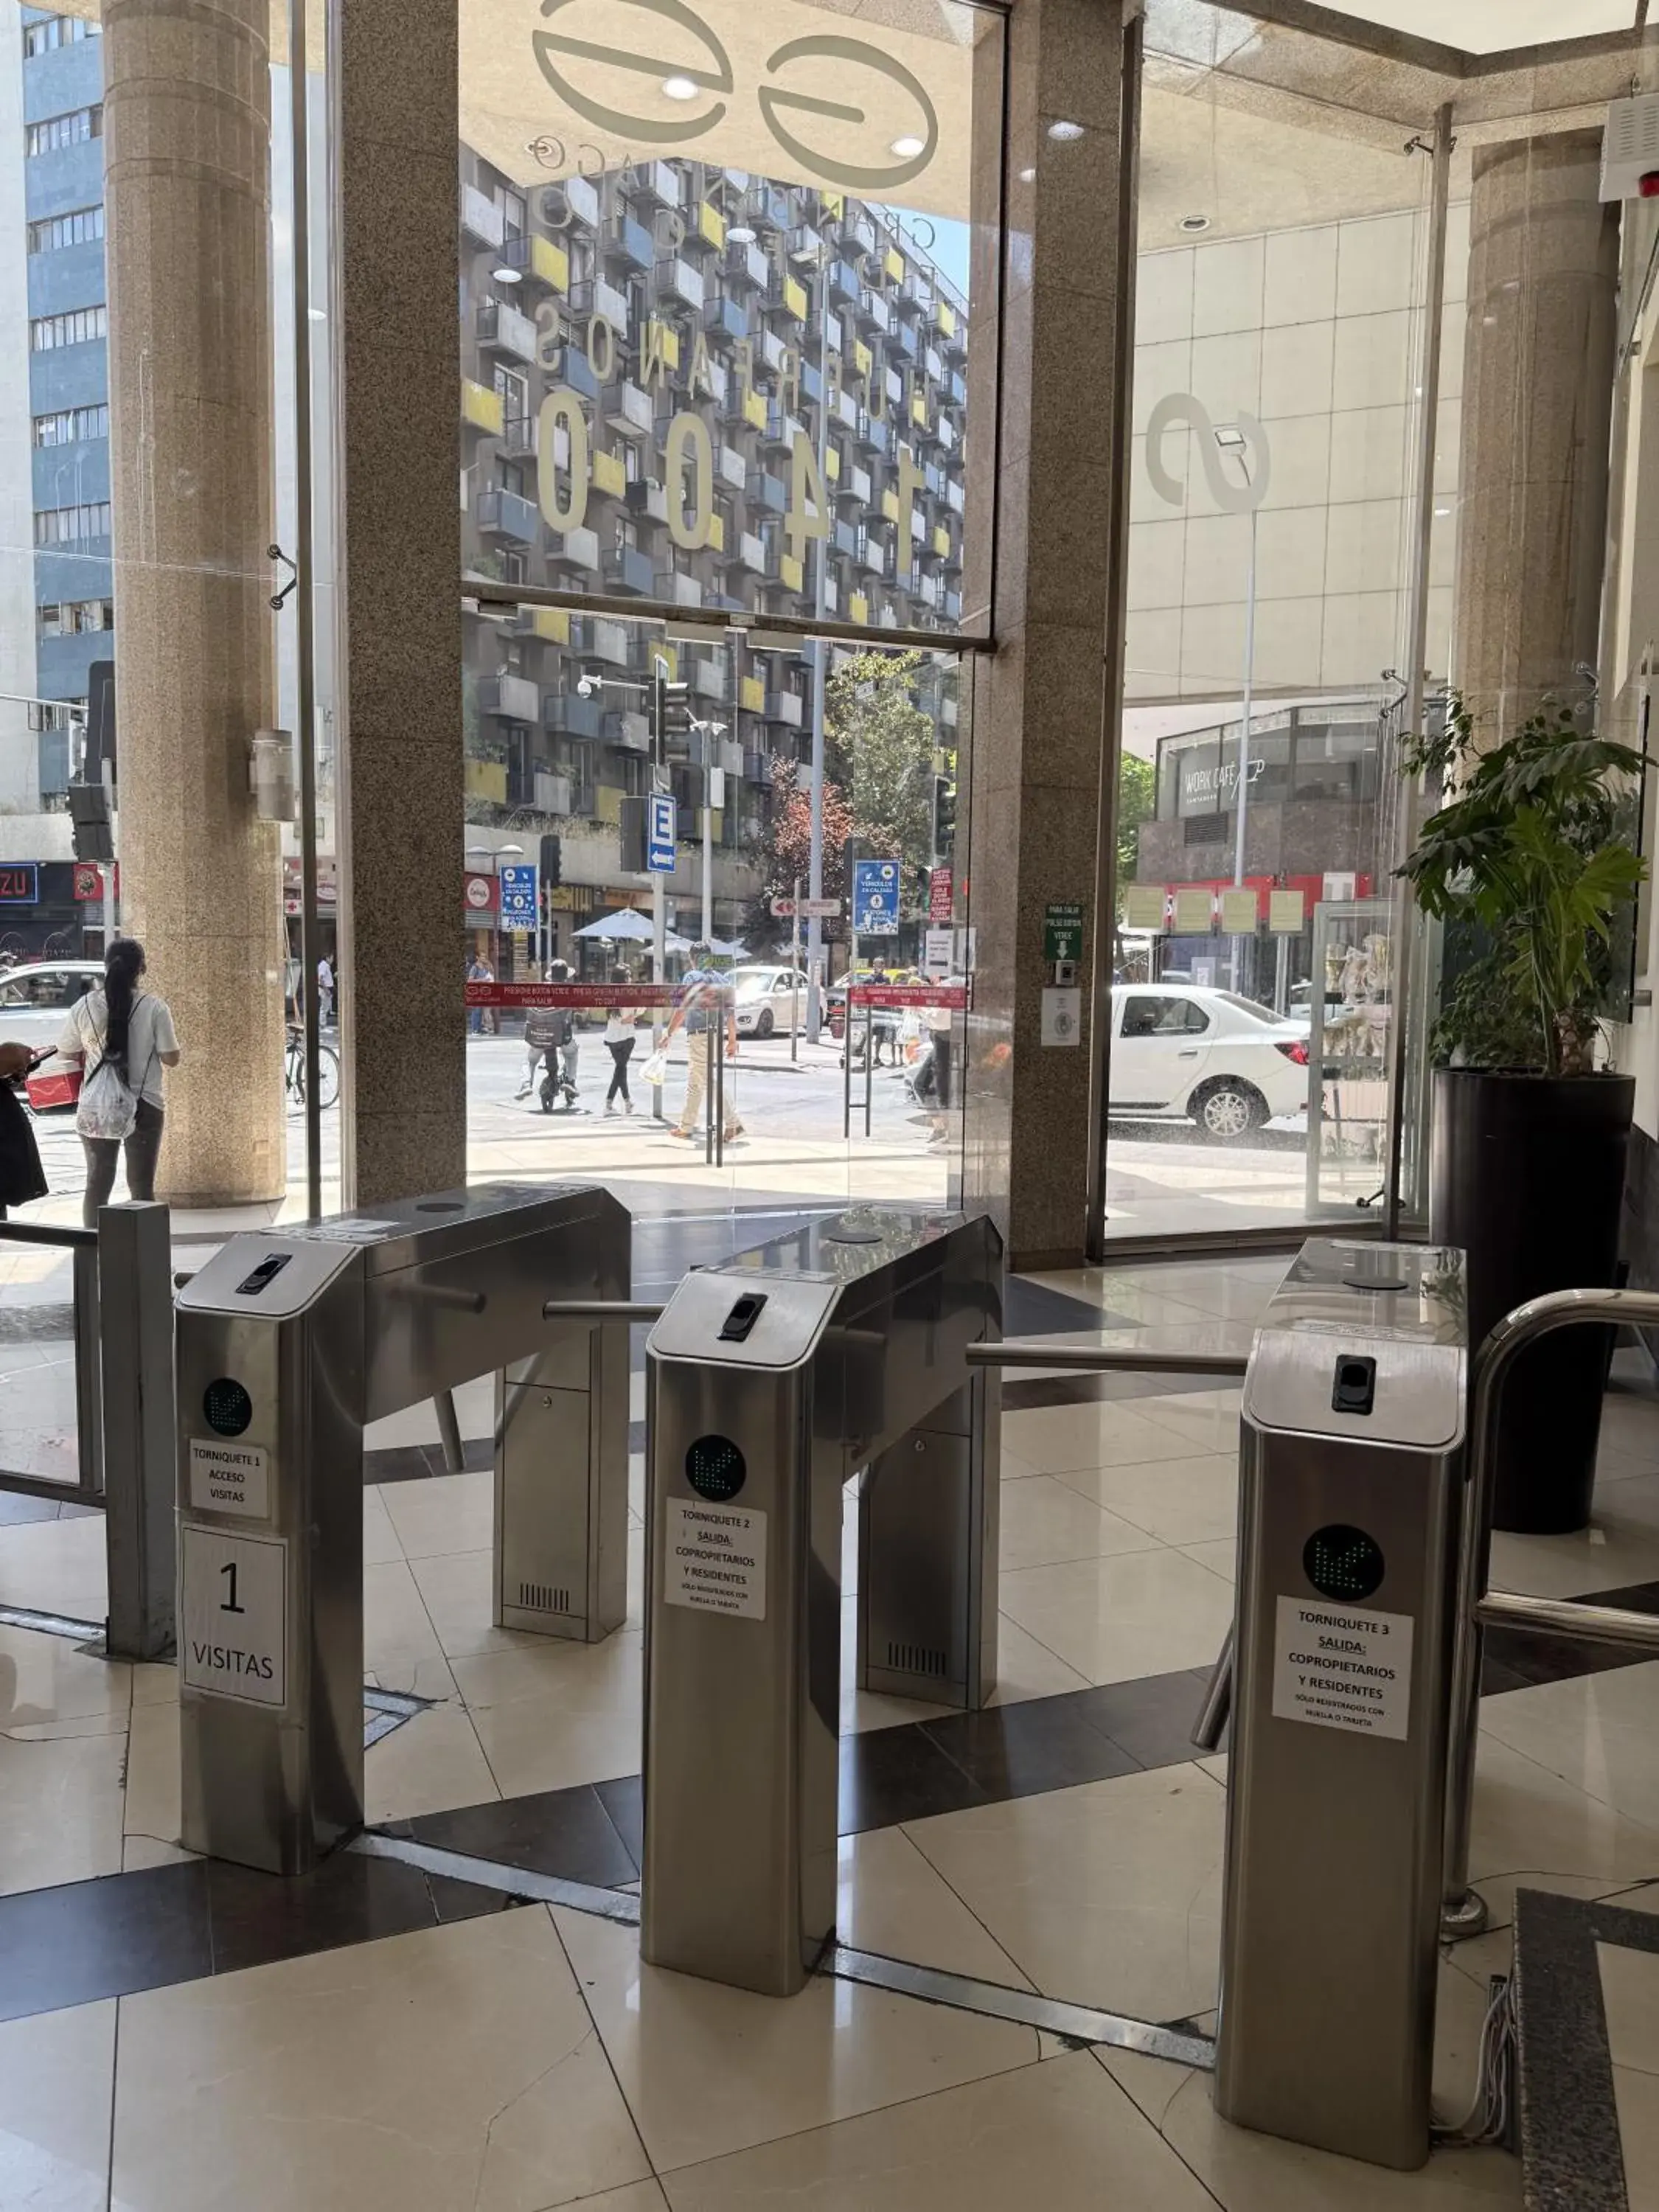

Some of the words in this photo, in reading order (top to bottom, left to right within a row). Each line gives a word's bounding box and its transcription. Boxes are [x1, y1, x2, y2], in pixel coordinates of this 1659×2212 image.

[1185, 770, 1211, 794] WORK
[655, 804, 669, 838] E
[193, 1447, 253, 1466] TORNIQUETE
[255, 1456, 260, 1467] 1
[209, 1470, 245, 1483] ACCESO
[210, 1488, 245, 1502] VISITAS
[682, 1509, 742, 1528] TORNIQUETE
[744, 1520, 750, 1528] 2
[675, 1545, 756, 1568] COPROPIETARIOS
[684, 1565, 690, 1576] Y
[692, 1568, 748, 1585] RESIDENTES
[220, 1562, 246, 1615] 1
[1298, 1610, 1378, 1634] TORNIQUETE
[1382, 1624, 1391, 1635] 3
[1318, 1635, 1367, 1656] SALIDA:
[192, 1641, 274, 1680] VISITAS
[1288, 1652, 1396, 1680] COPROPIETARIOS
[1298, 1674, 1307, 1686] Y
[1309, 1677, 1383, 1700] RESIDENTES
